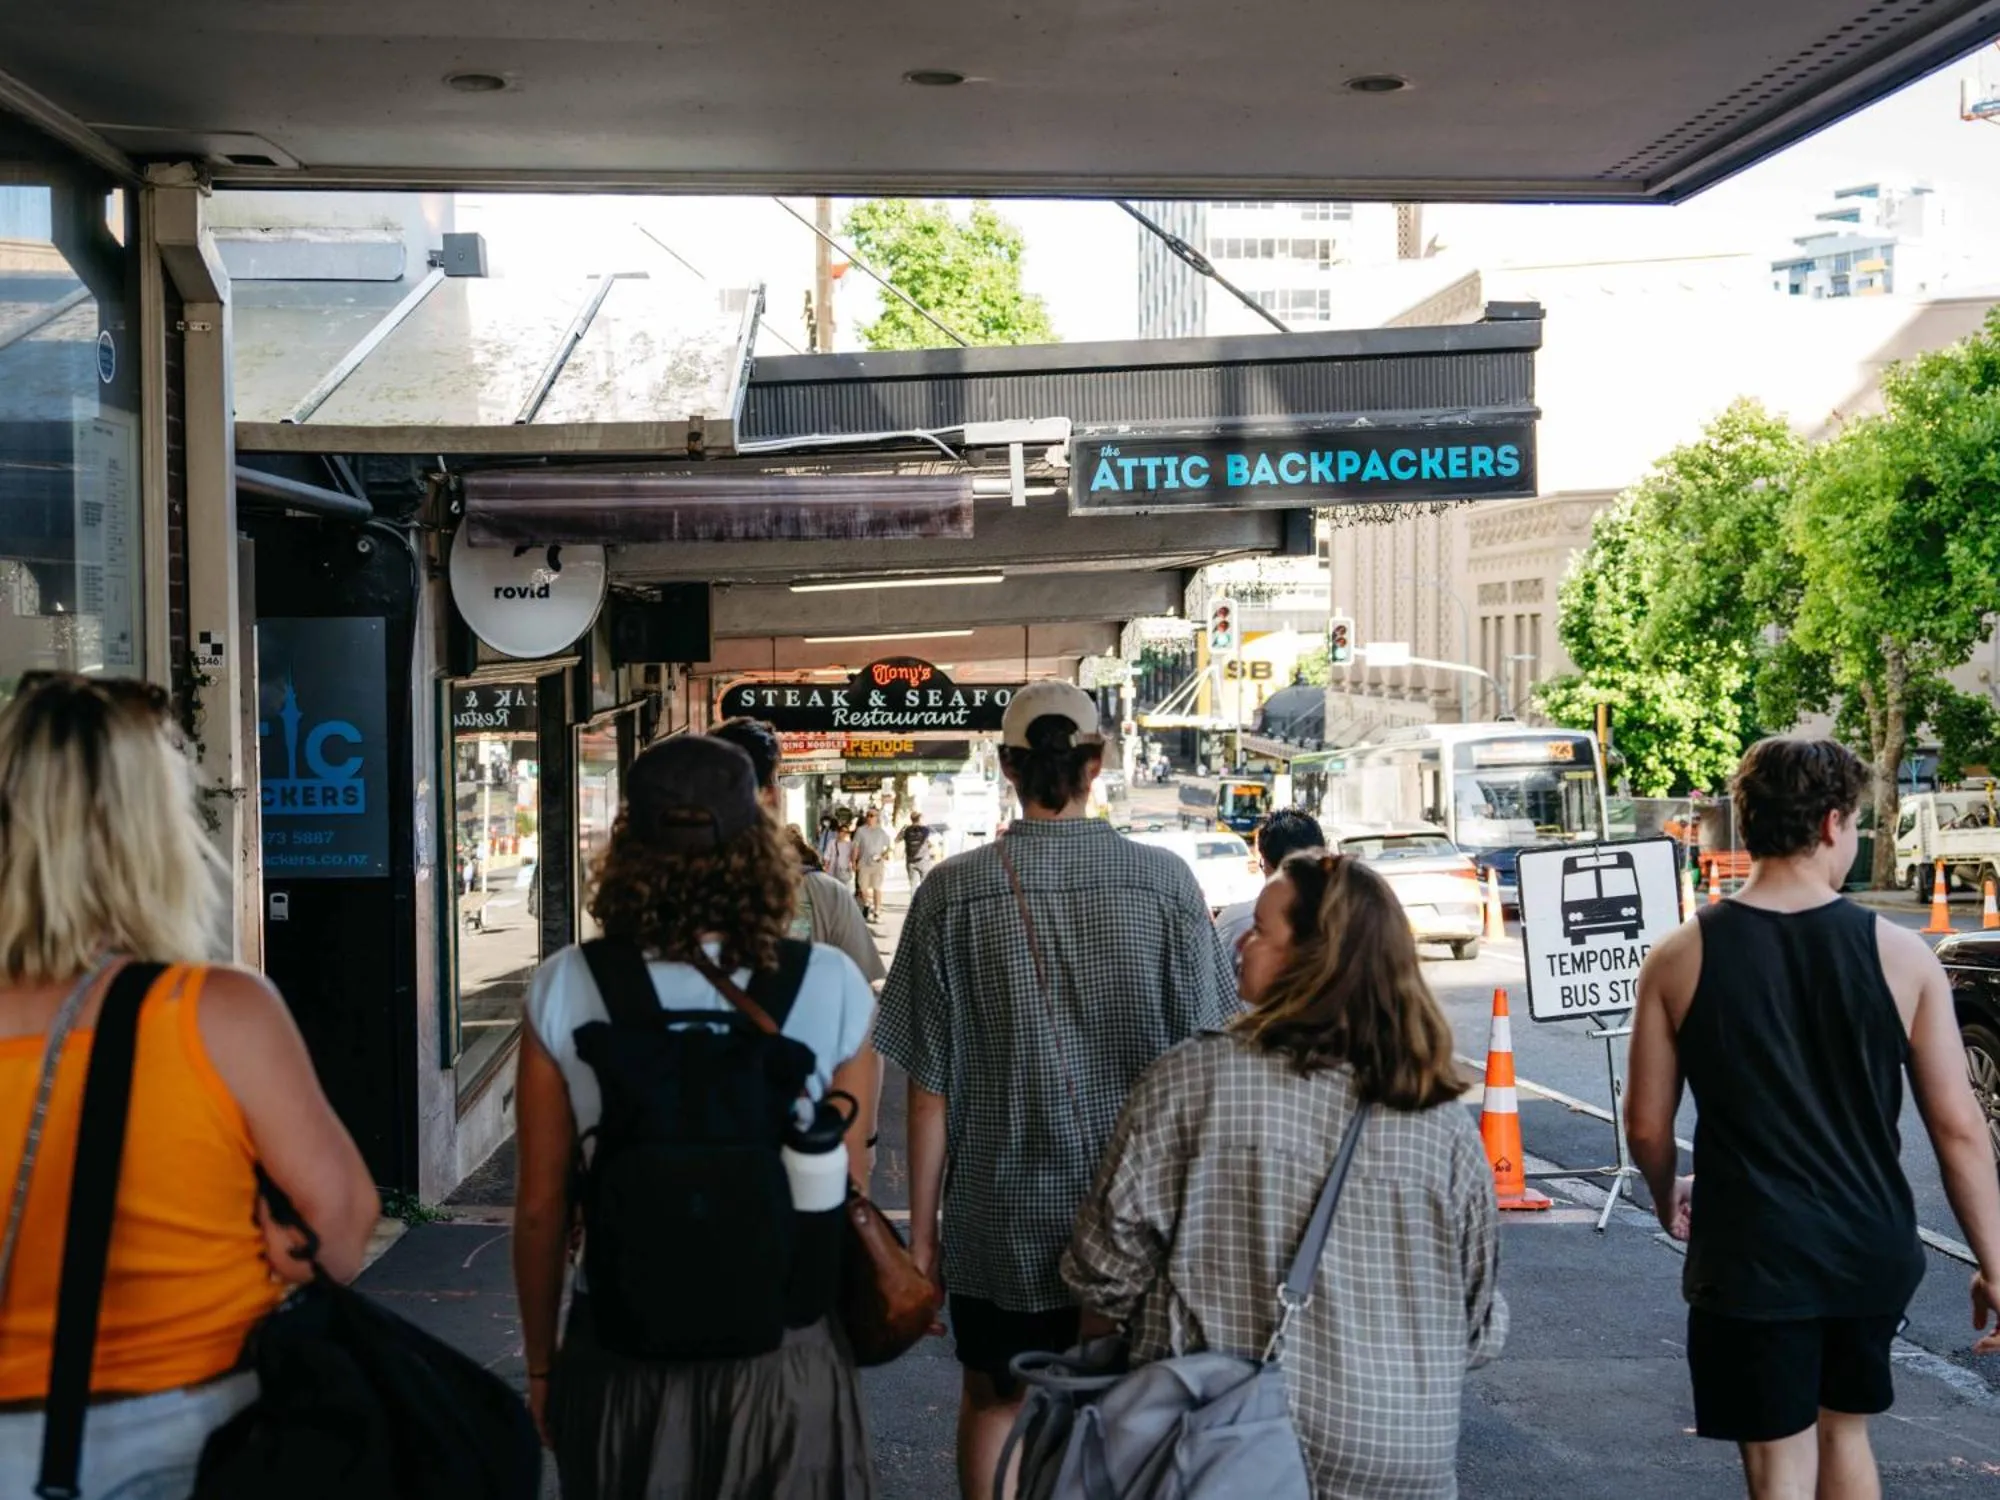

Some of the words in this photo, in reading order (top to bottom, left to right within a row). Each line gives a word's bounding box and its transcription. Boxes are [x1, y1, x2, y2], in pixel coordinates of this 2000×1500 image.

[1090, 456, 1210, 491] ATTIC
[1227, 444, 1521, 487] BACKPACKERS
[494, 583, 550, 599] rovid
[872, 663, 932, 687] Tony's
[740, 689, 850, 707] STEAK
[868, 689, 887, 706] &
[832, 707, 971, 727] Restaurant
[1560, 982, 1600, 1009] BUS
